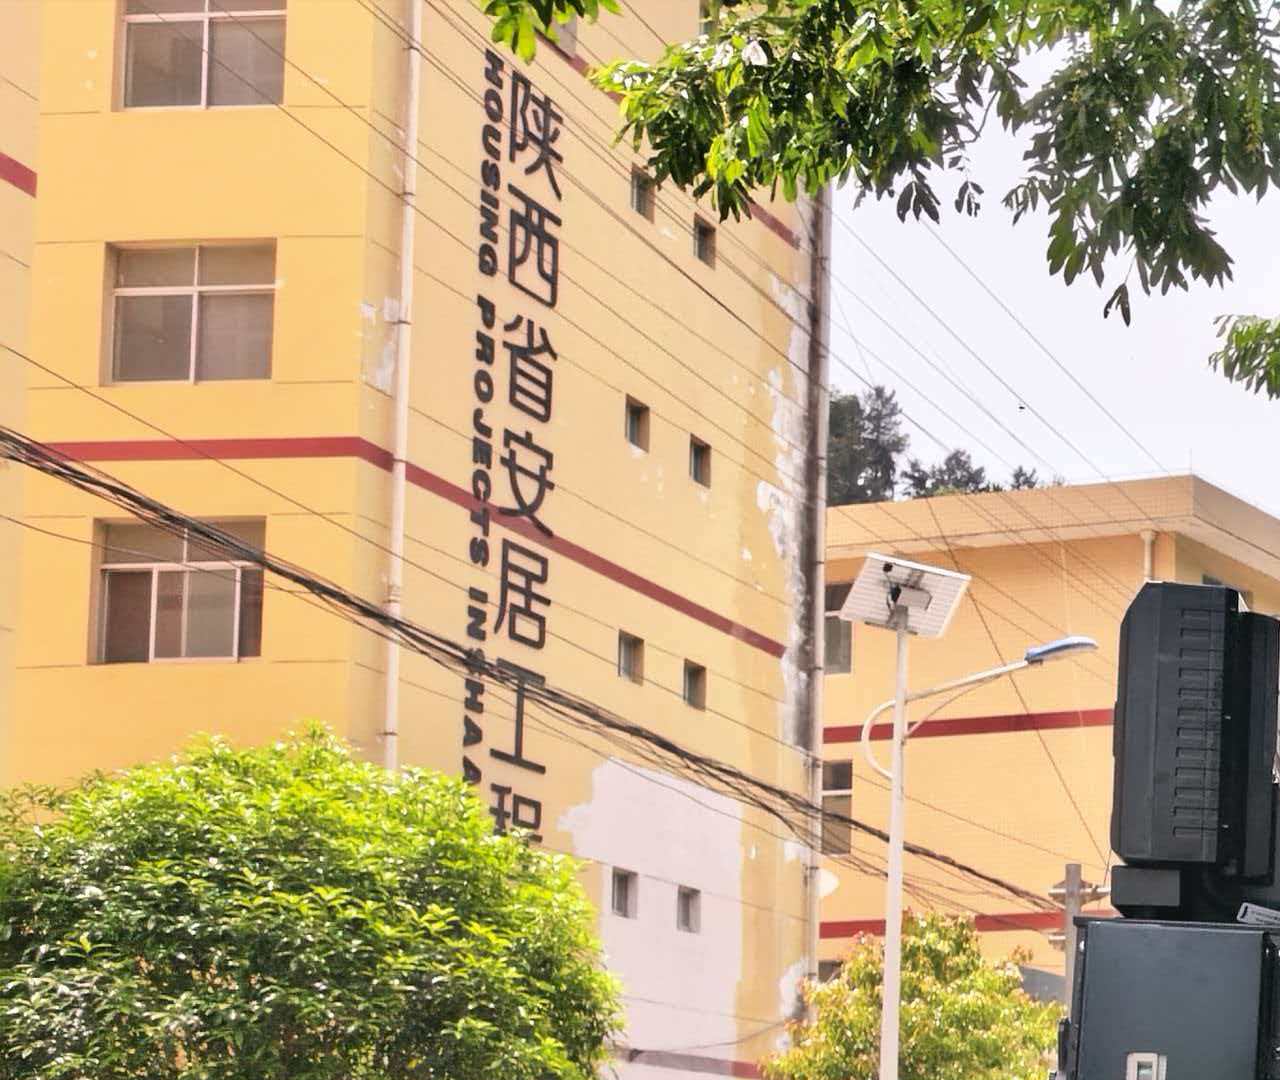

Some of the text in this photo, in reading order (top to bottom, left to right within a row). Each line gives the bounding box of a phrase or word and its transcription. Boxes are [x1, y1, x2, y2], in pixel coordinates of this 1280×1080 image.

[479, 48, 504, 277] HOUSING
[469, 294, 495, 567] PROJECTS
[467, 586, 488, 642] IN
